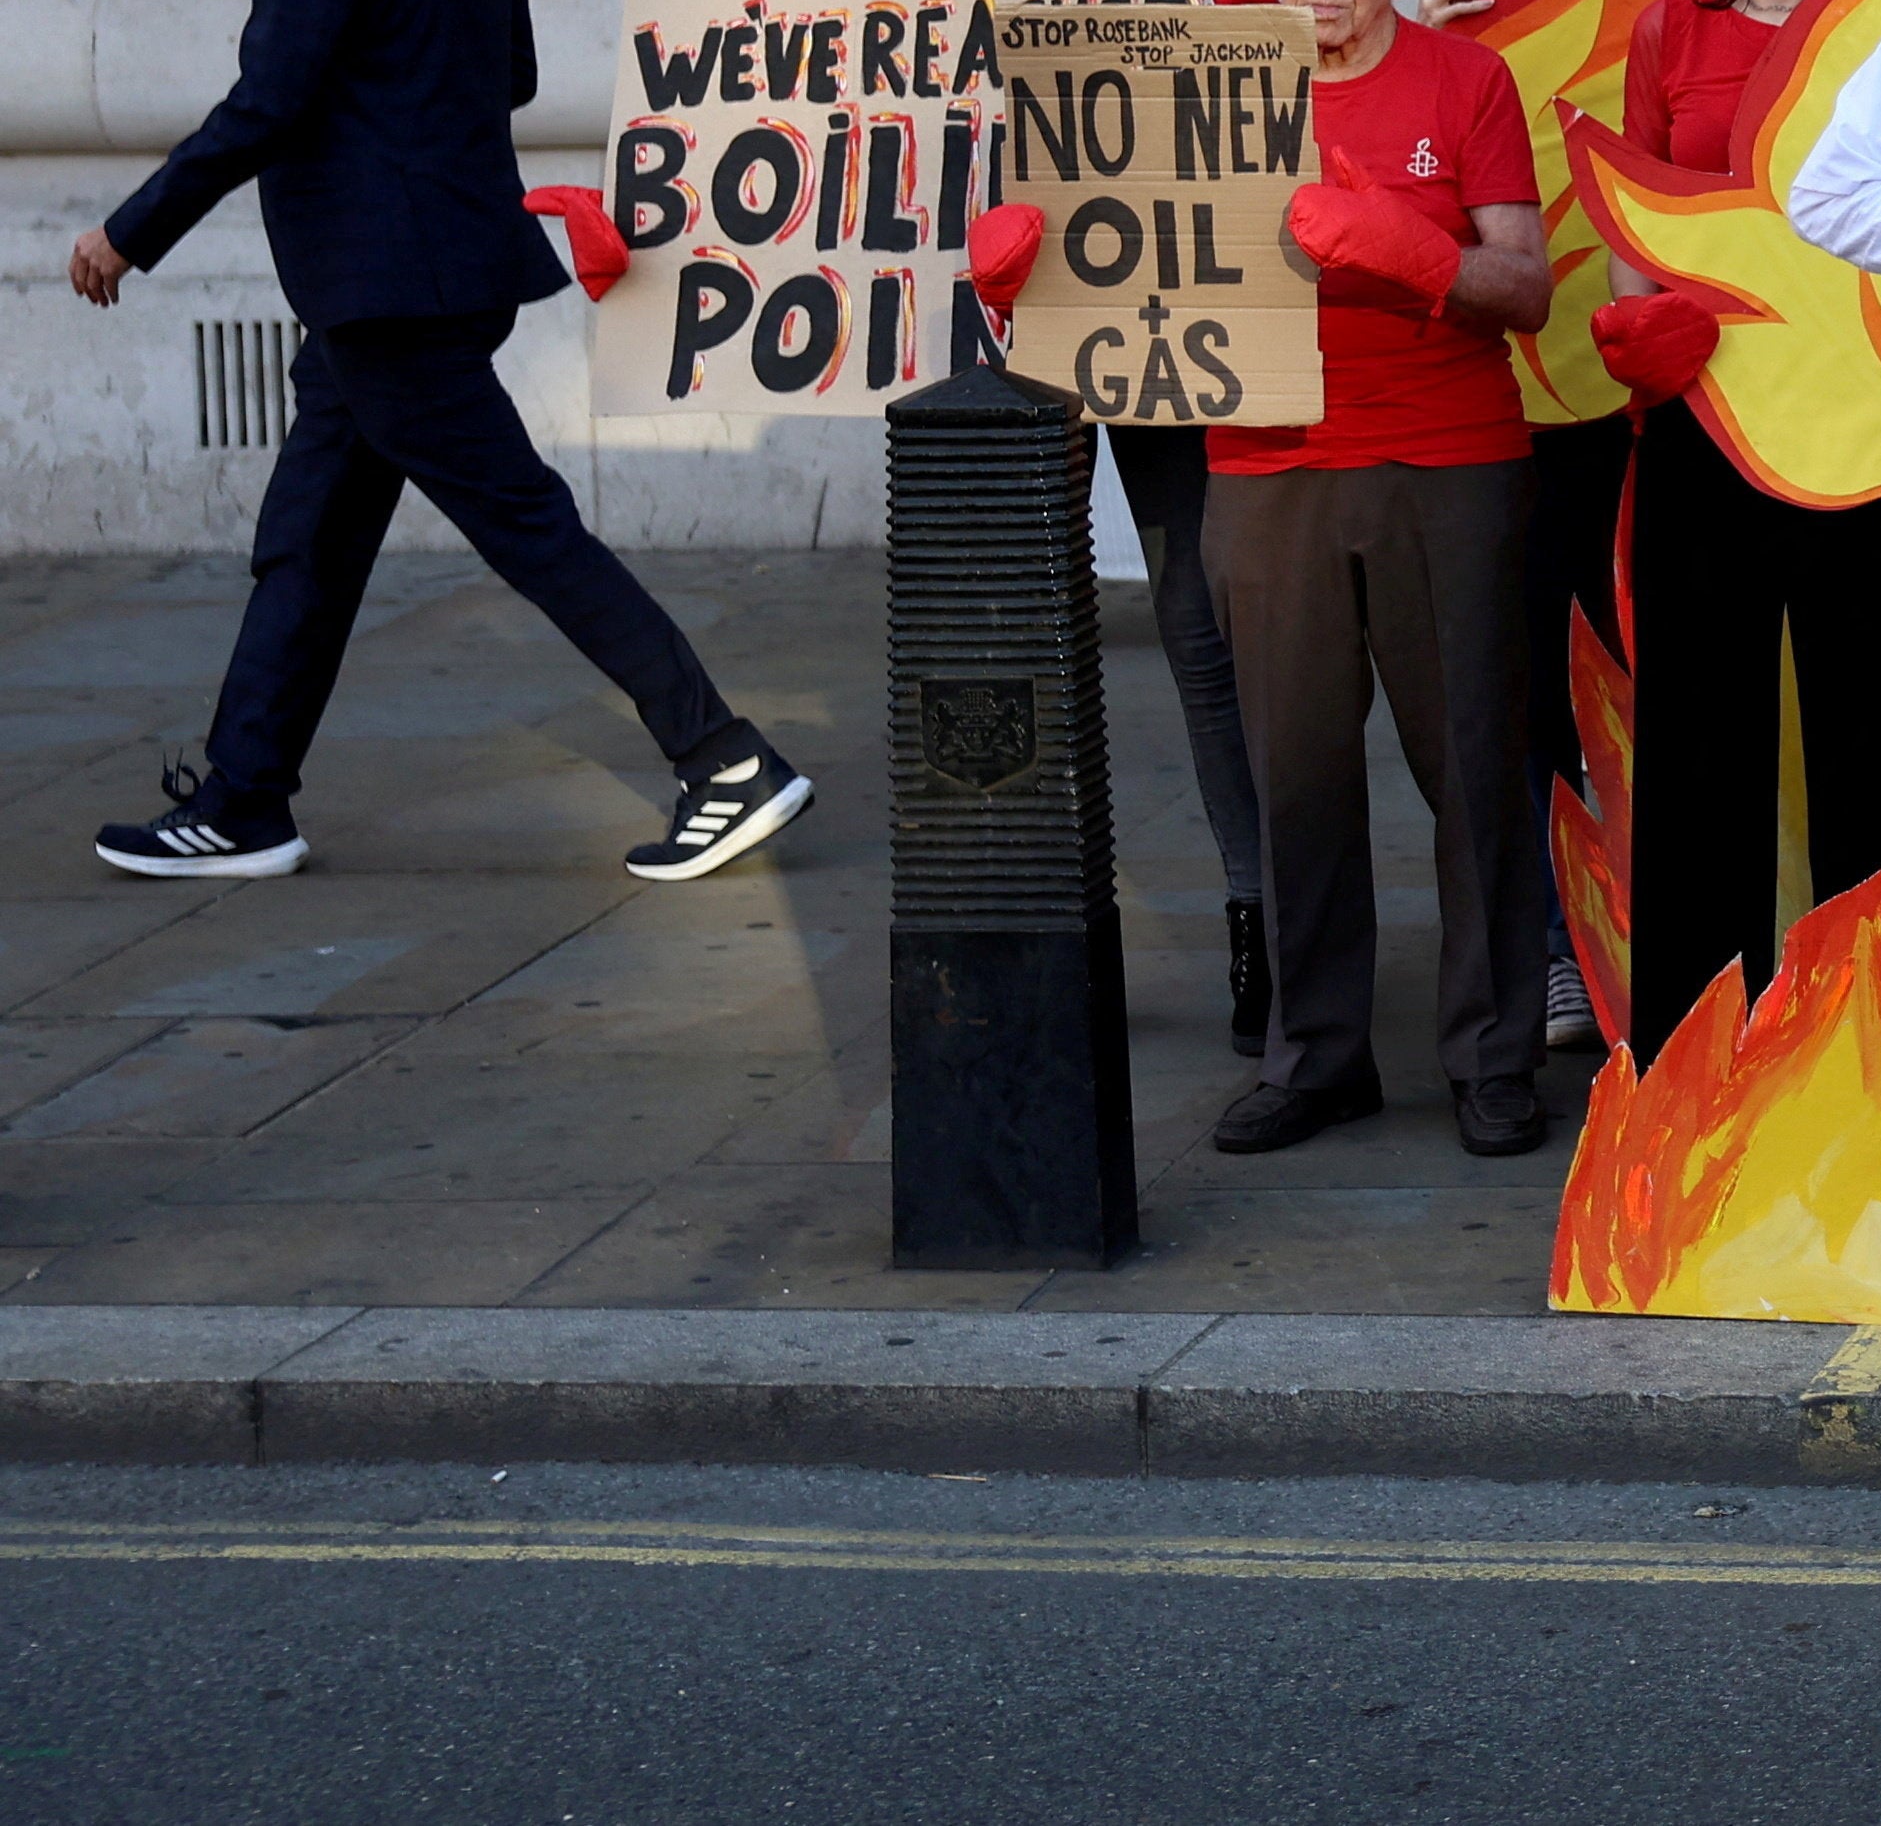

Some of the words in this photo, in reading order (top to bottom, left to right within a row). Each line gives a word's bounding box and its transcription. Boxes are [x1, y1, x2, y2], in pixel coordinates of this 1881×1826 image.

[1002, 16, 1079, 49] STOP
[1086, 17, 1192, 43] ROSEBANK
[1120, 45, 1173, 66] STOP
[1190, 40, 1285, 64] JACKDAW
[1012, 67, 1134, 183] NO
[1173, 66, 1310, 182] NEW
[615, 100, 1004, 252] BOILI
[1063, 196, 1243, 289] OIL
[667, 246, 1008, 399] POIN
[1139, 293, 1172, 332] +
[1074, 319, 1243, 422] GAS
